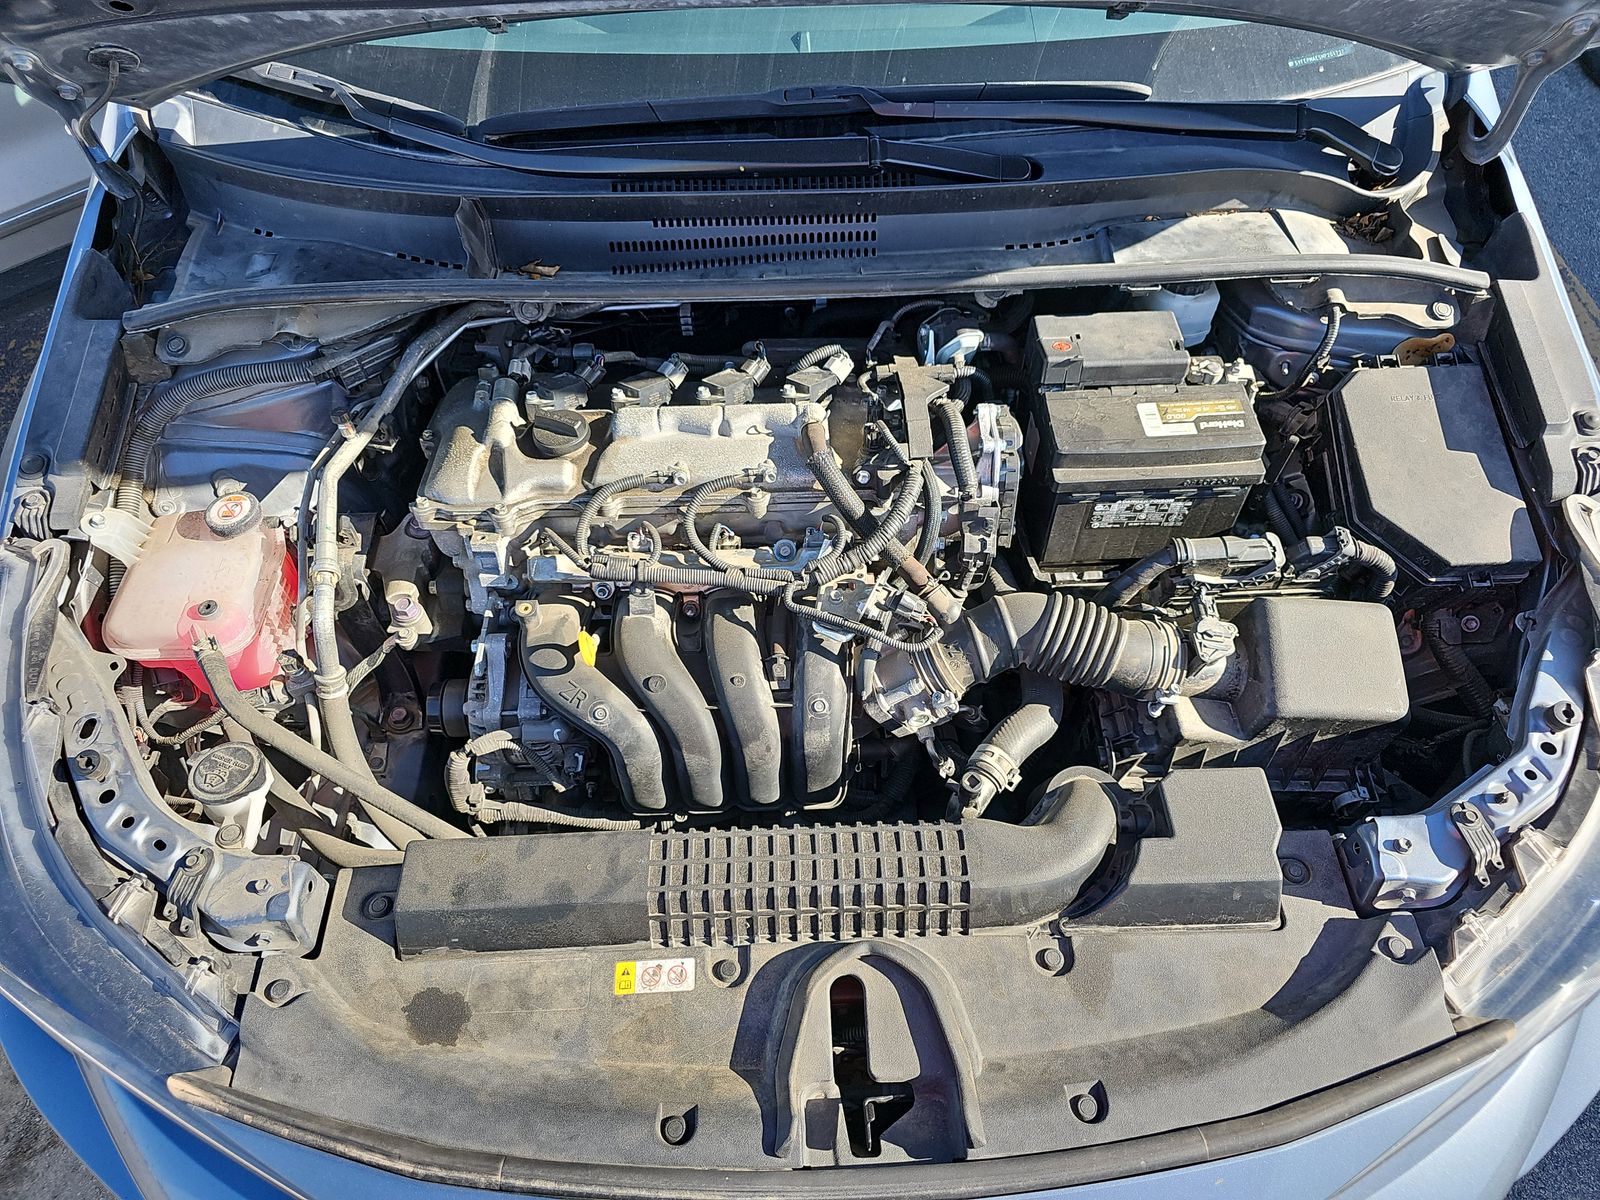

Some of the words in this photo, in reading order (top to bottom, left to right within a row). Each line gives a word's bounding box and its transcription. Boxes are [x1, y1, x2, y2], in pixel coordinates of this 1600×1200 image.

[1390, 394, 1414, 402] RELAY
[1199, 419, 1246, 430] DieHard
[558, 679, 588, 708] ZR
